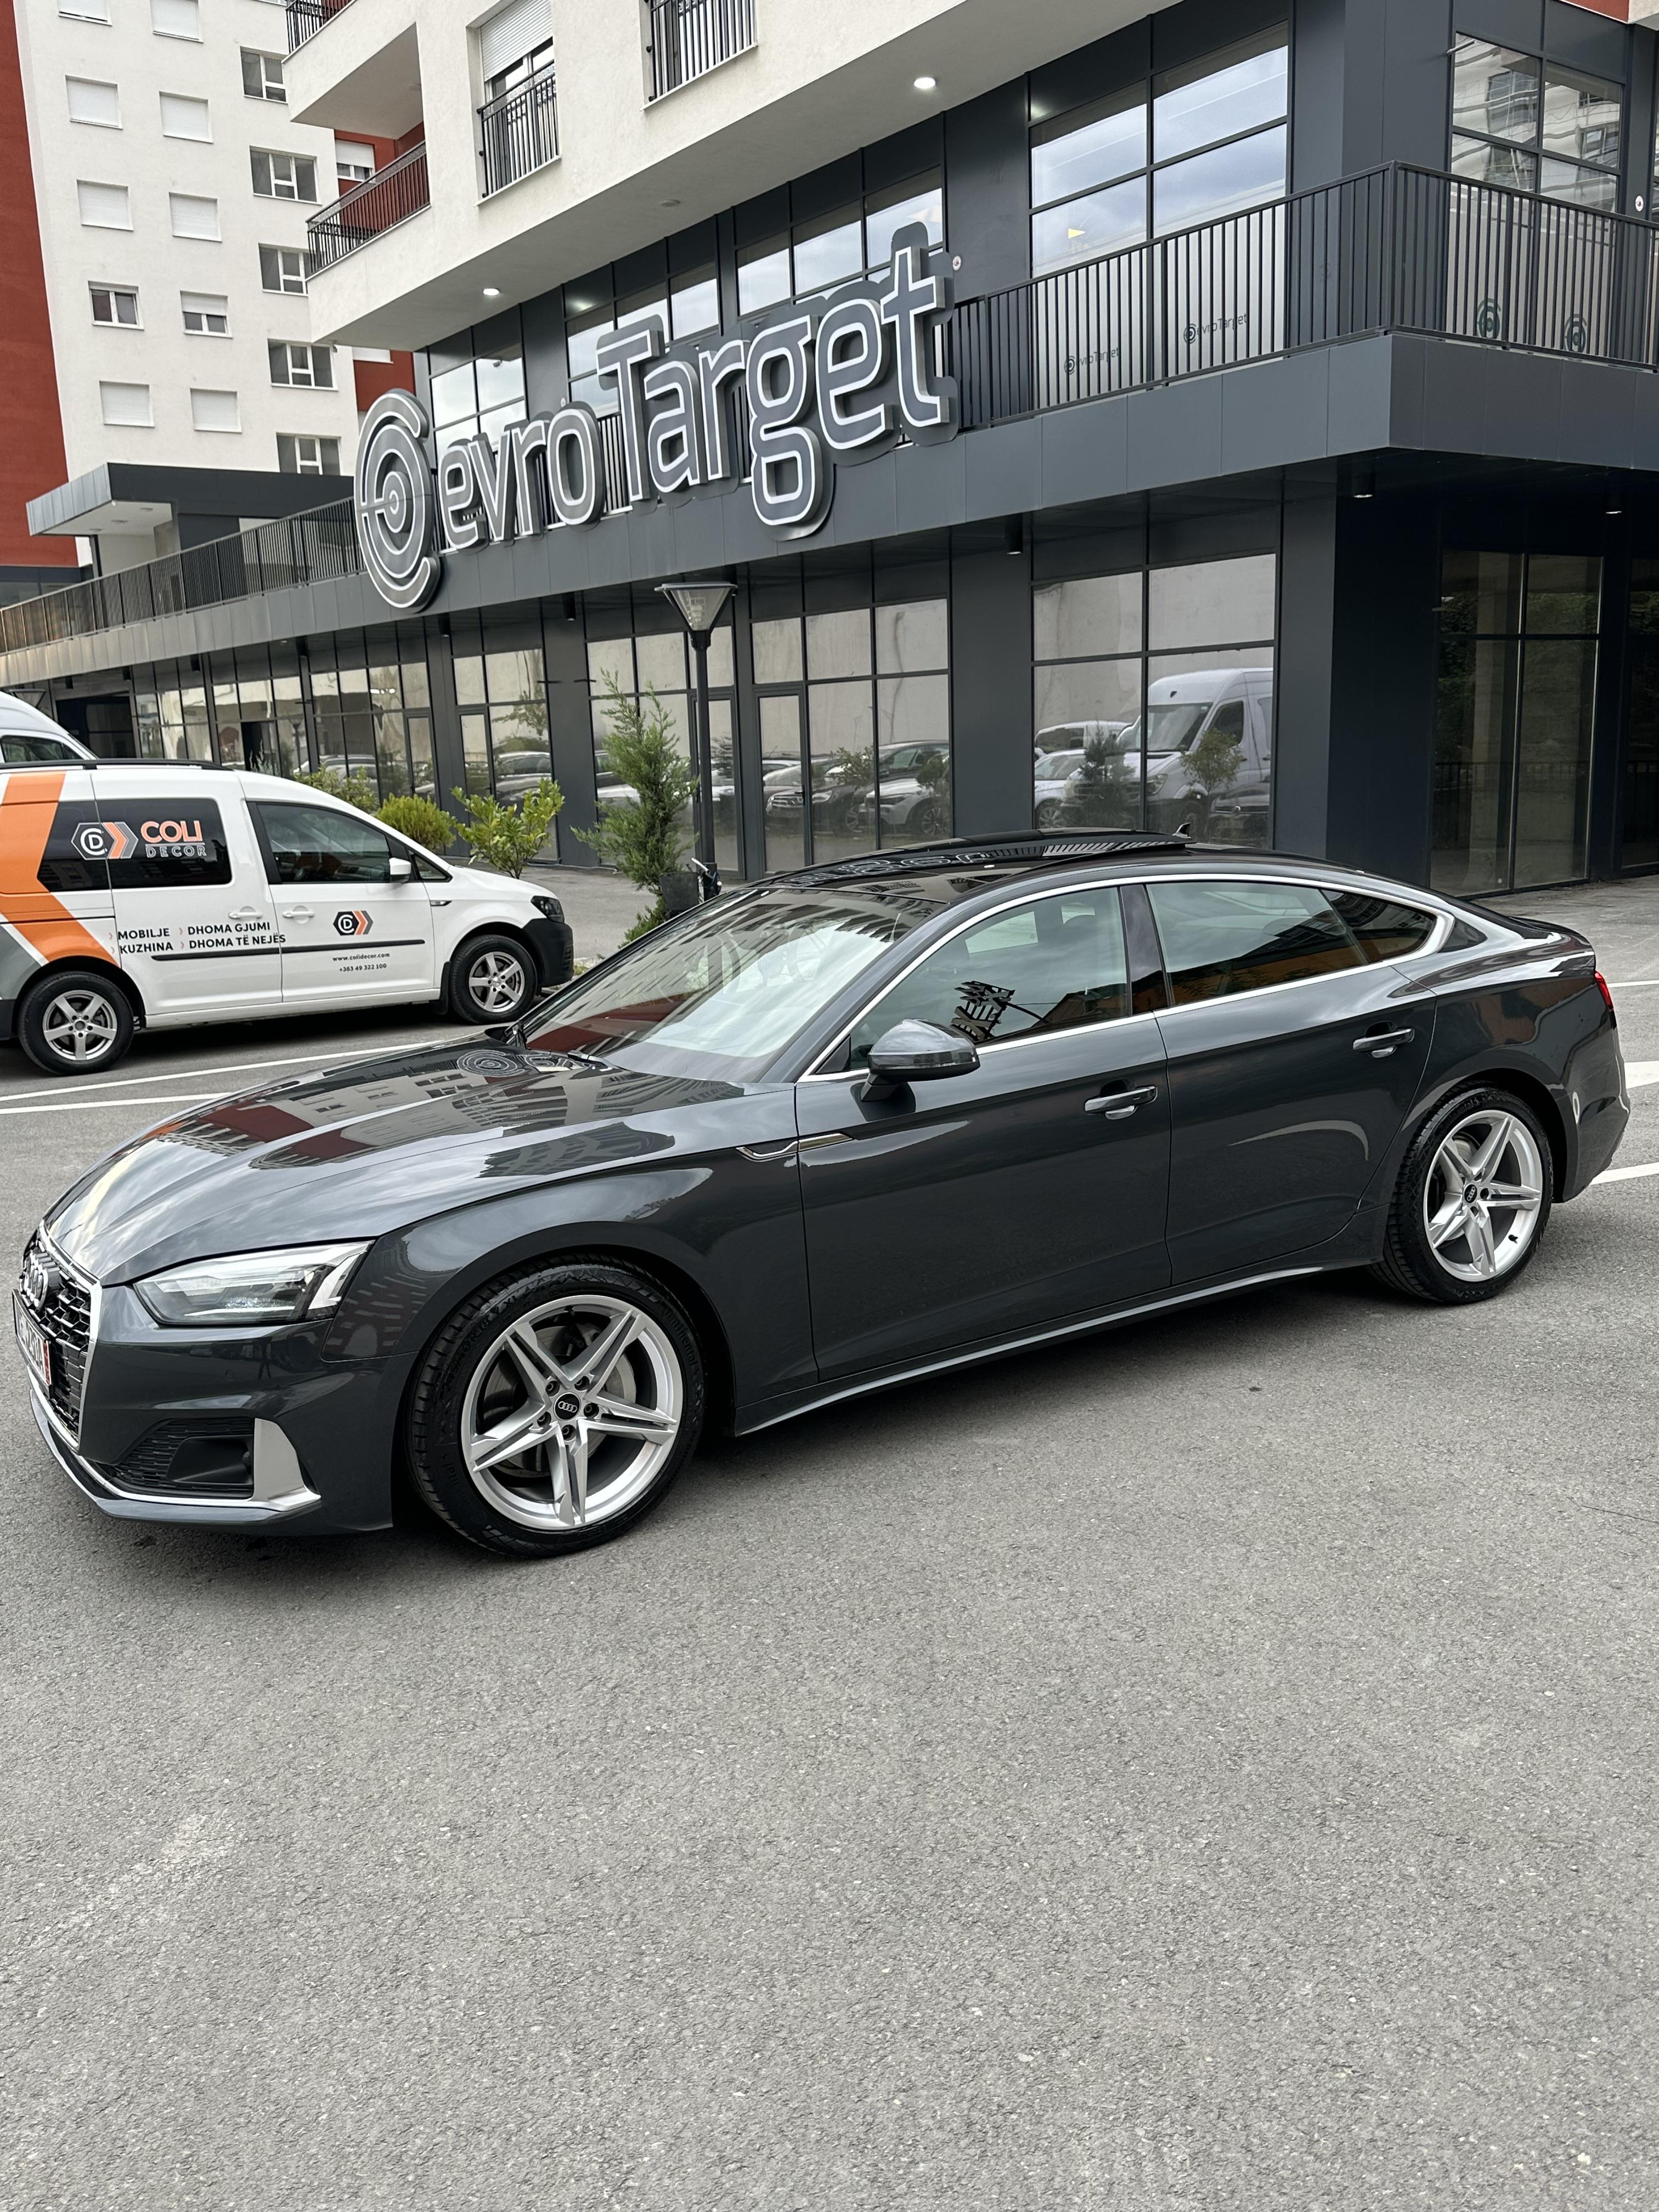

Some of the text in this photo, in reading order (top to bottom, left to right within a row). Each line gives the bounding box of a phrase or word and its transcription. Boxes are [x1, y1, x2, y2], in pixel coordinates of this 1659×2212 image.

[140, 820, 203, 844] COLI
[145, 845, 207, 859] DECOR
[117, 928, 171, 940] MOBILJE
[188, 922, 270, 935] DHOMA GJUMI
[119, 941, 174, 954] KUZHINA
[189, 933, 286, 949] DHOMA TË NEJËS
[332, 953, 390, 961] www.colidecor.com
